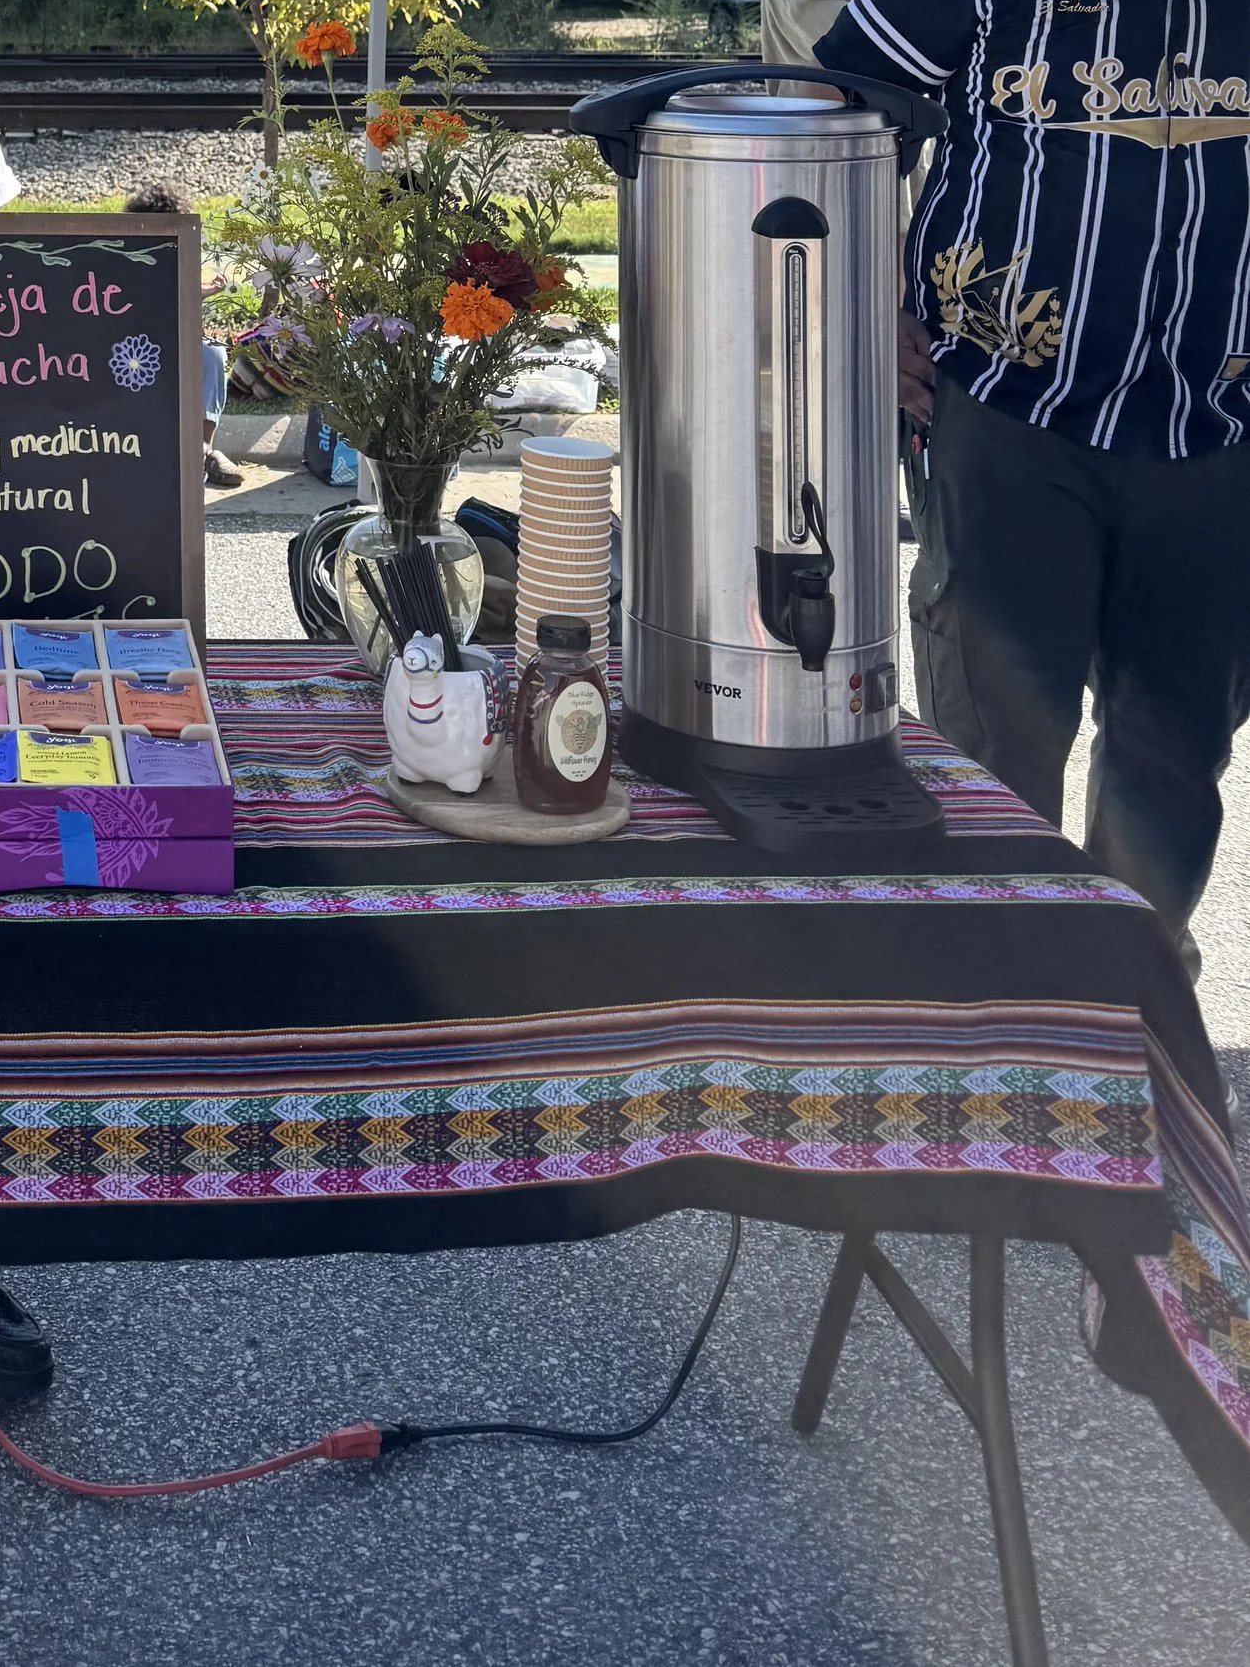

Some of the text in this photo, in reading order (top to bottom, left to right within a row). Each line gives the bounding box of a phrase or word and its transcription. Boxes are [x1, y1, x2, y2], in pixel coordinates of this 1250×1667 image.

[990, 61, 1057, 119] El
[72, 272, 133, 316] de
[11, 420, 142, 460] medicina
[34, 645, 81, 654] Bedtime
[157, 647, 182, 655] Deep
[693, 679, 742, 699] VEVOR
[30, 699, 97, 709] Cold Season
[46, 736, 77, 744] yogi
[560, 754, 597, 765] Wildflower Honey
